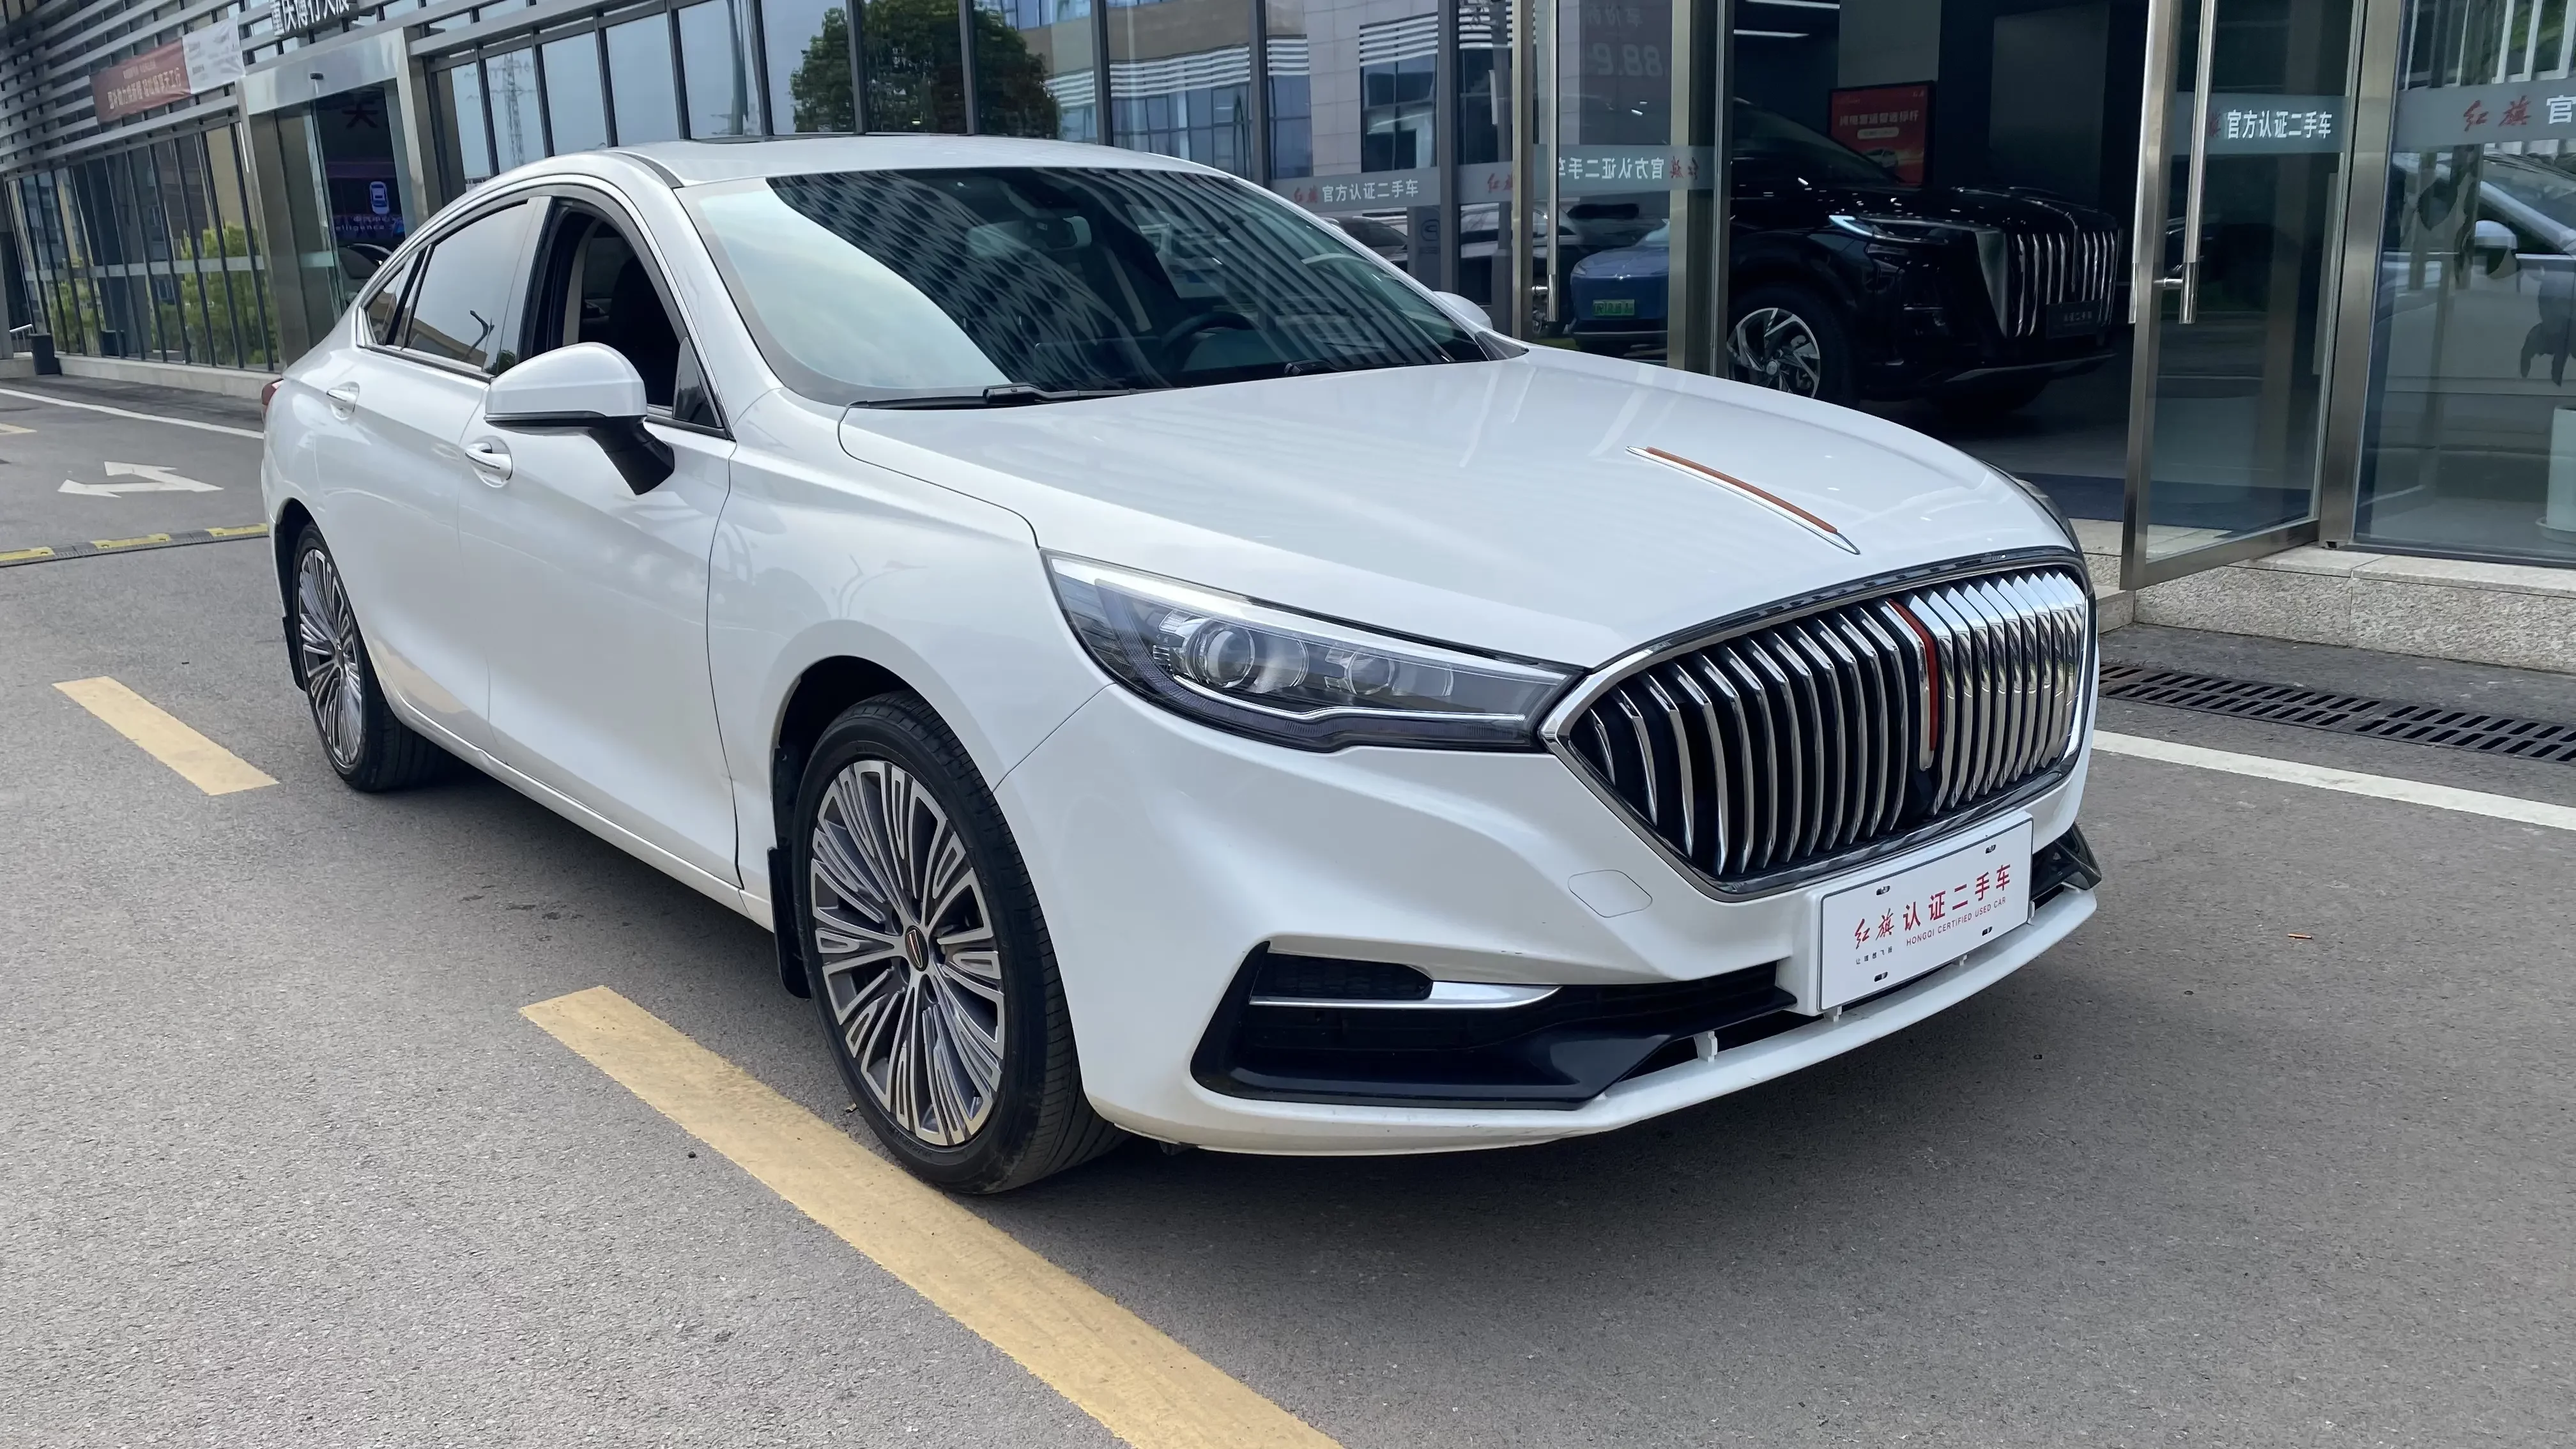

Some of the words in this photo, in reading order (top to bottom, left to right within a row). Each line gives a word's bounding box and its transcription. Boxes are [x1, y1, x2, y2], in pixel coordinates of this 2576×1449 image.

[2227, 109, 2332, 139] 官方认证二手车
[2464, 95, 2532, 132] 红旗
[2546, 95, 2576, 125] 官
[1322, 179, 1418, 203] 官方认证二手车
[1906, 929, 1935, 946] HONGQI
[1938, 912, 1972, 933] CERTIFIED
[1975, 904, 1991, 917] USED
[1993, 896, 2005, 908] CAR
